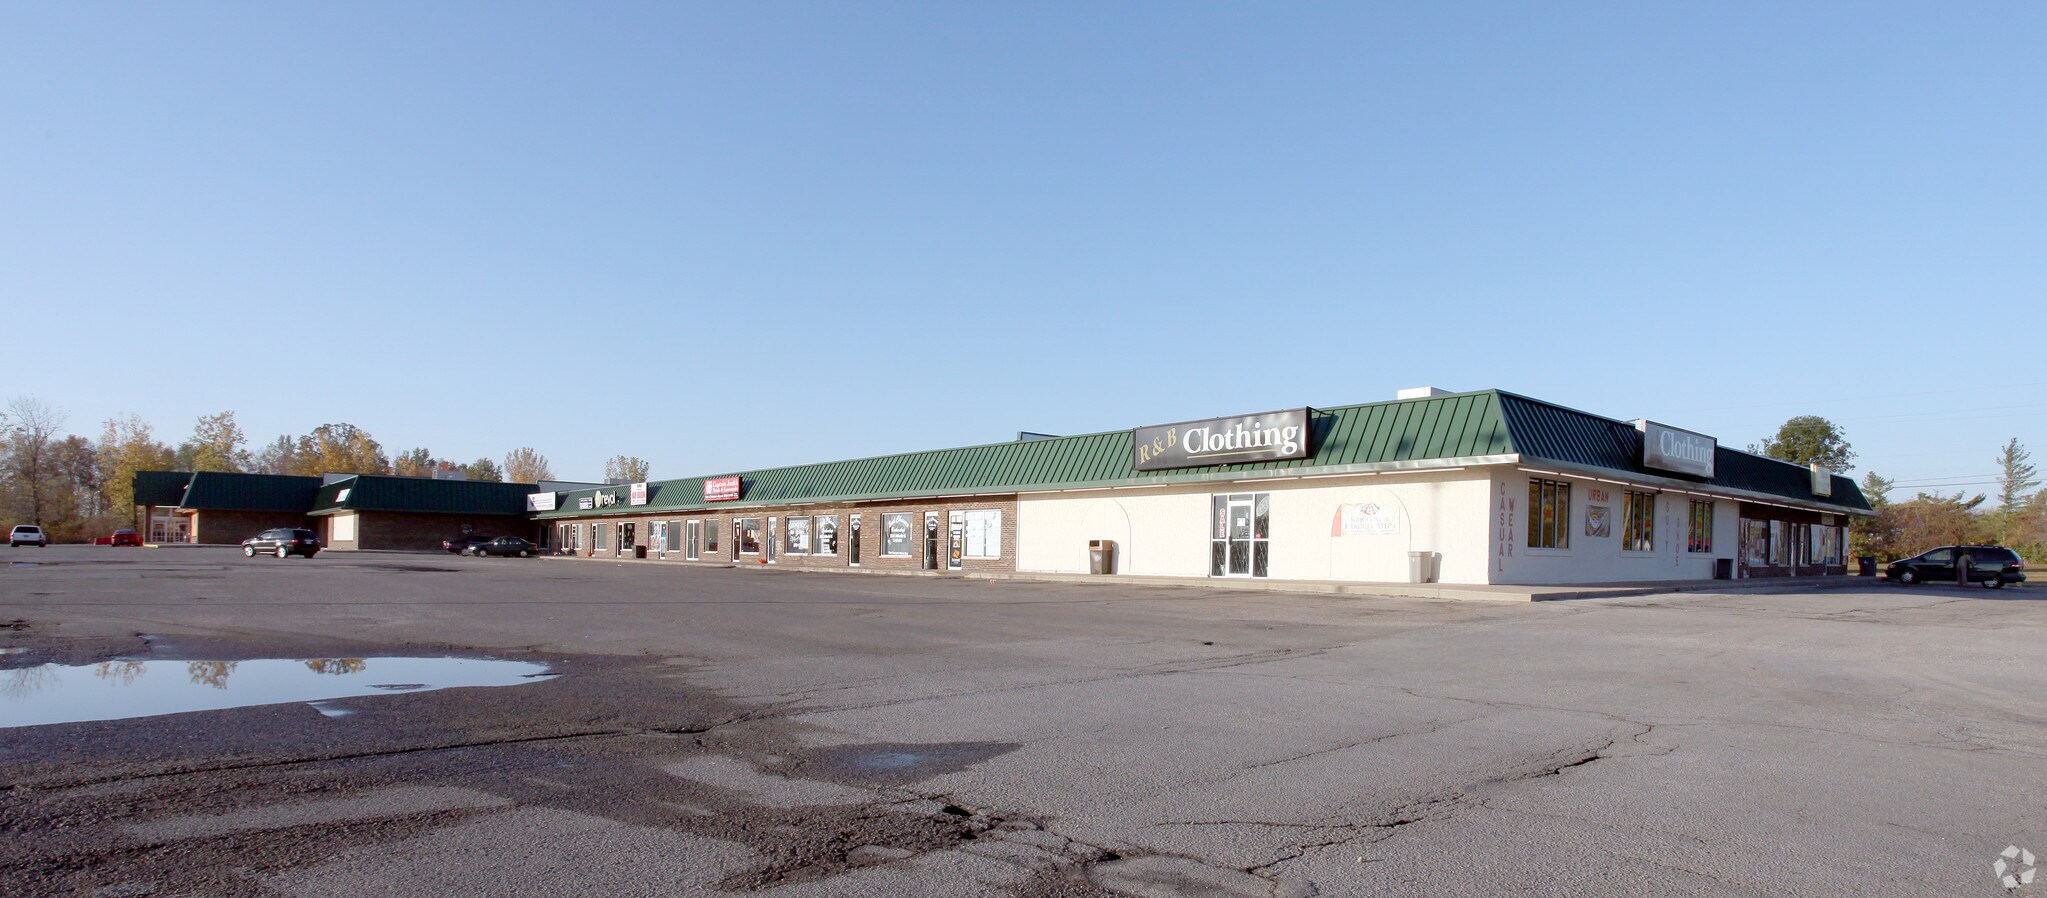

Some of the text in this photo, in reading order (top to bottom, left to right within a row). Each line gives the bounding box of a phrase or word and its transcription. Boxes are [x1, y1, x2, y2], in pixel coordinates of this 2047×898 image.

[1140, 421, 1299, 465] R & B Clothing
[1660, 430, 1713, 474] Clothing
[1587, 489, 1609, 503] URBAN
[1218, 507, 1226, 538] SALE
[1498, 482, 1506, 572] CASUAL
[1507, 498, 1515, 558] WEAR
